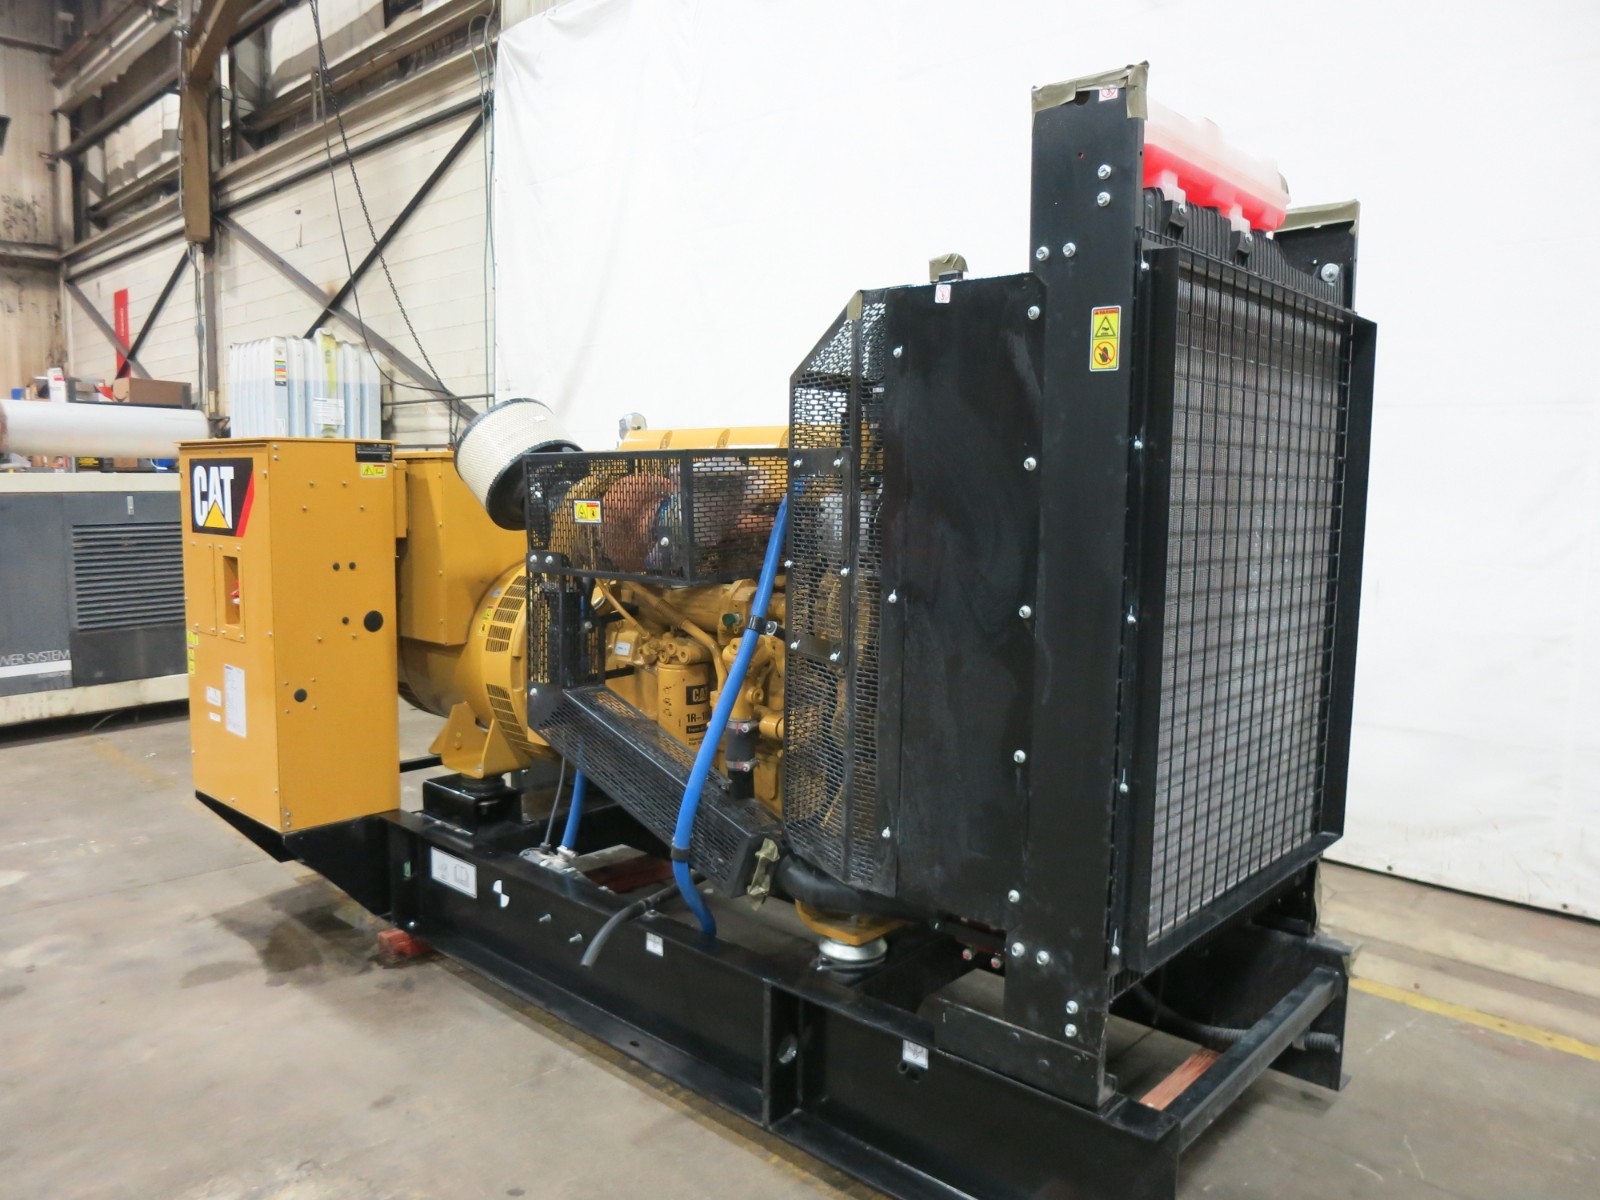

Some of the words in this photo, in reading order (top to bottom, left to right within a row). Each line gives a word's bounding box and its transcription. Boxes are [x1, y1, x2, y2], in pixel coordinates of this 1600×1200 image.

[194, 466, 234, 529] CAT
[27, 649, 71, 664] SYSTEM
[692, 687, 706, 703] CA
[686, 712, 706, 723] 1R-1
